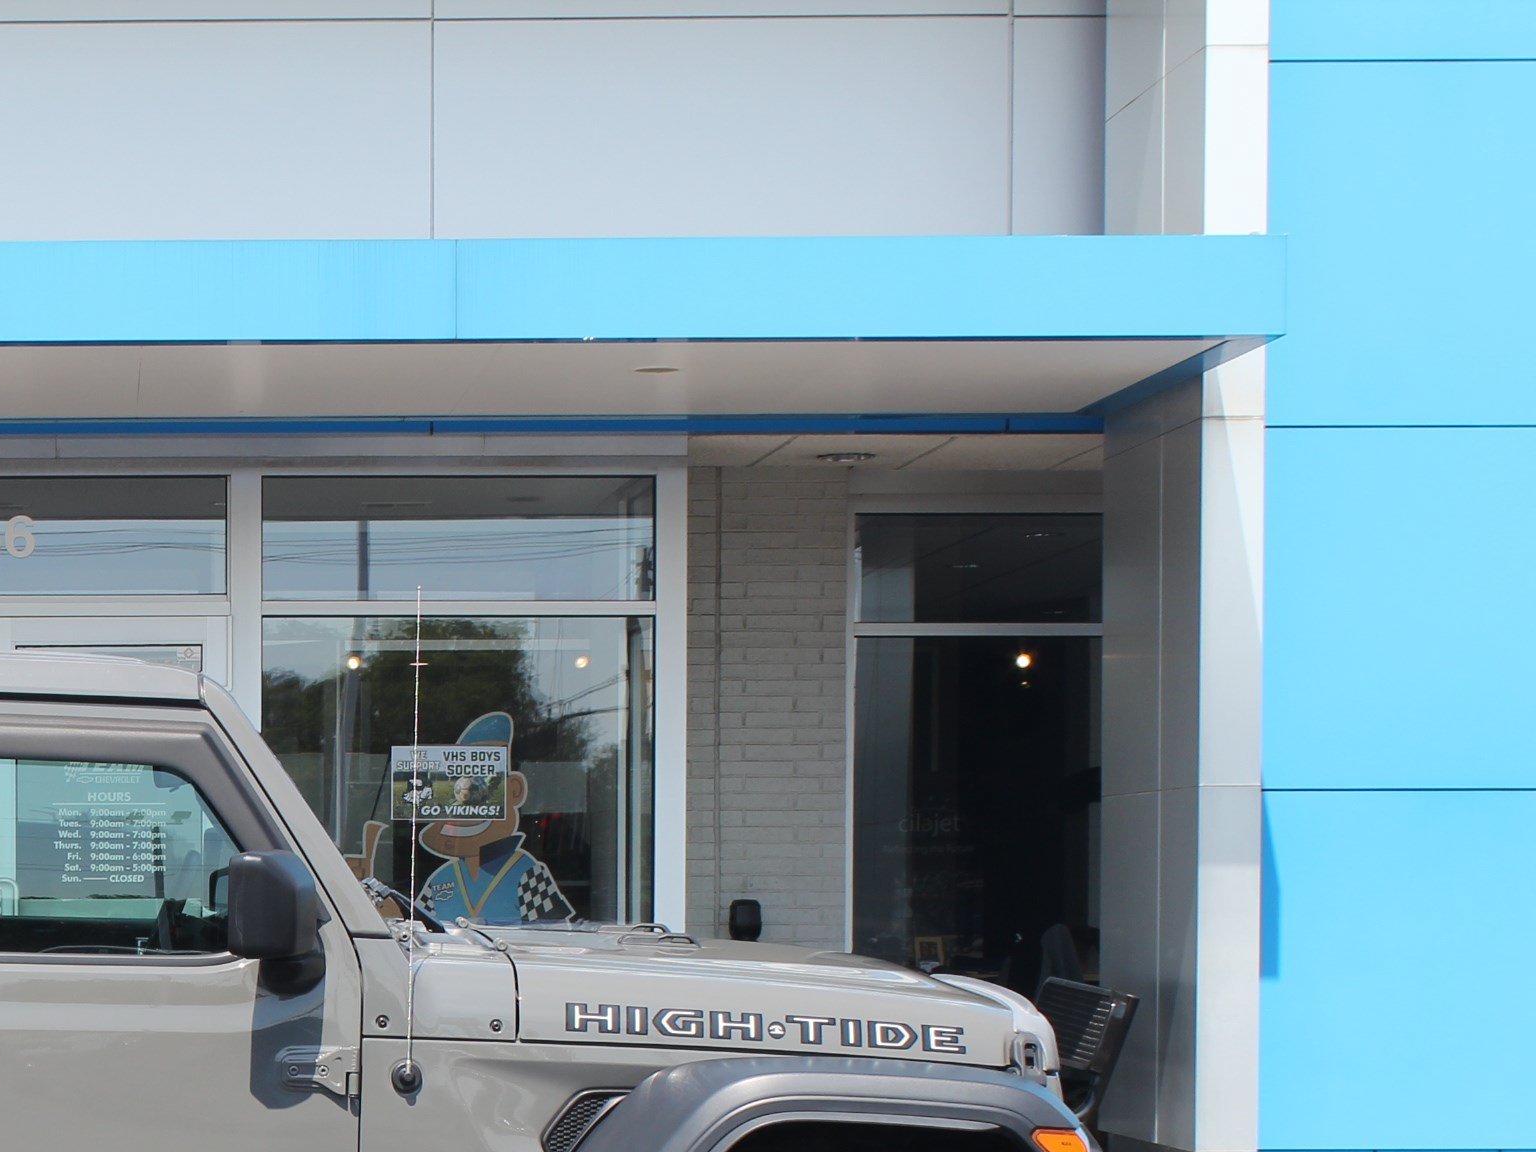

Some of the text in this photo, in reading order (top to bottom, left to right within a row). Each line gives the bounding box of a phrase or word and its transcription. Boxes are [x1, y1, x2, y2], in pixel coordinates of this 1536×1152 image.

[410, 750, 427, 760] WE
[443, 751, 501, 762] VHS BOYS
[397, 761, 440, 770] SUPPORT
[447, 764, 496, 776] SOCCER
[95, 775, 141, 784] CHEVROLET
[87, 791, 132, 802] HOURS
[58, 808, 81, 817] Mon.
[90, 808, 124, 817] 9:00am
[132, 808, 166, 818] 7:00pm
[421, 805, 501, 816] GO VIKINGS!
[59, 819, 81, 828] Tues.
[90, 819, 124, 828] 9:00am
[132, 819, 166, 829] 7:00pm
[898, 812, 960, 837] cilajet
[58, 830, 81, 838] Wed.
[90, 830, 124, 838] 9:00am
[132, 830, 166, 840] 7:00pm
[54, 841, 81, 849] Thurs.
[90, 841, 124, 849] 9:00am
[132, 841, 166, 851] 7:00pm
[67, 852, 81, 860] Fri.
[90, 852, 124, 860] 9:00am
[132, 852, 166, 862] 6:00pm
[64, 863, 81, 871] Sat.
[90, 863, 124, 871] 9:00am
[132, 863, 166, 873] 5:00pm
[61, 874, 145, 883] Sun. CLOSED
[432, 882, 454, 891] TEAM
[565, 1002, 967, 1055] HIGH TIDE
